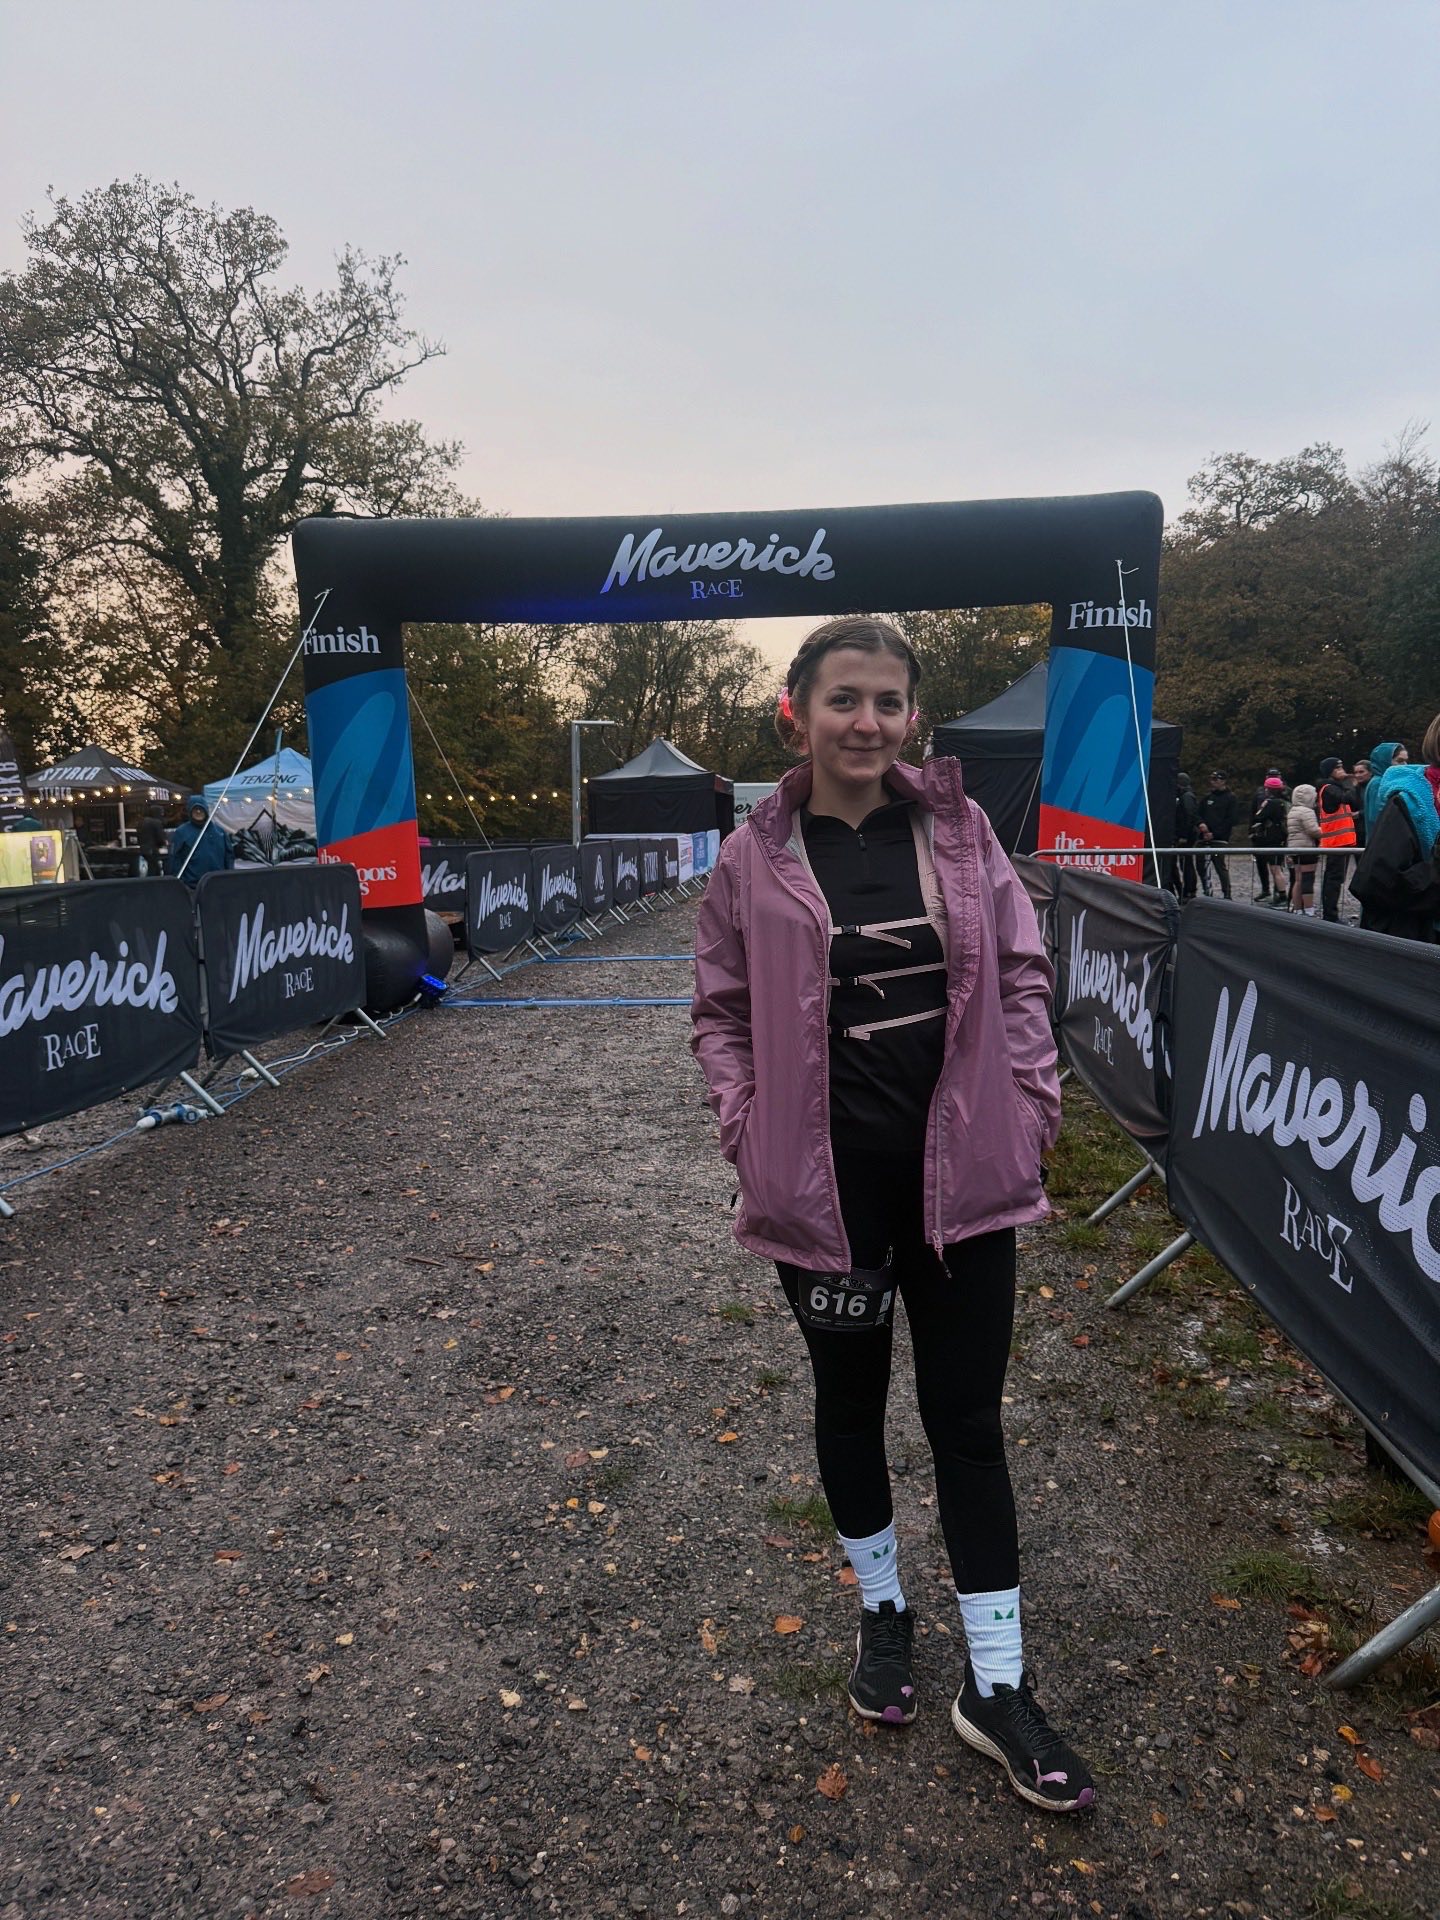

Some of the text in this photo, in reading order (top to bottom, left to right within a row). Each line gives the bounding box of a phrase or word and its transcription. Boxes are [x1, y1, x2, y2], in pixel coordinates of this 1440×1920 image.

[600, 528, 836, 594] Maverick
[690, 579, 744, 600] RACE
[1067, 600, 1152, 630] Finish
[302, 626, 381, 656] Finish
[1055, 831, 1085, 850] the
[357, 866, 397, 882] oors
[540, 863, 578, 911] Maverick
[477, 870, 529, 929] Maverick
[229, 902, 355, 1004] Maverick
[0, 930, 179, 1038] averick
[284, 966, 314, 999] RACE
[1066, 908, 1154, 1070] Maverick
[43, 1023, 102, 1073] RACE
[1093, 1015, 1115, 1067] RACE
[1279, 1176, 1354, 1294] RACE
[810, 1285, 868, 1317] 616
